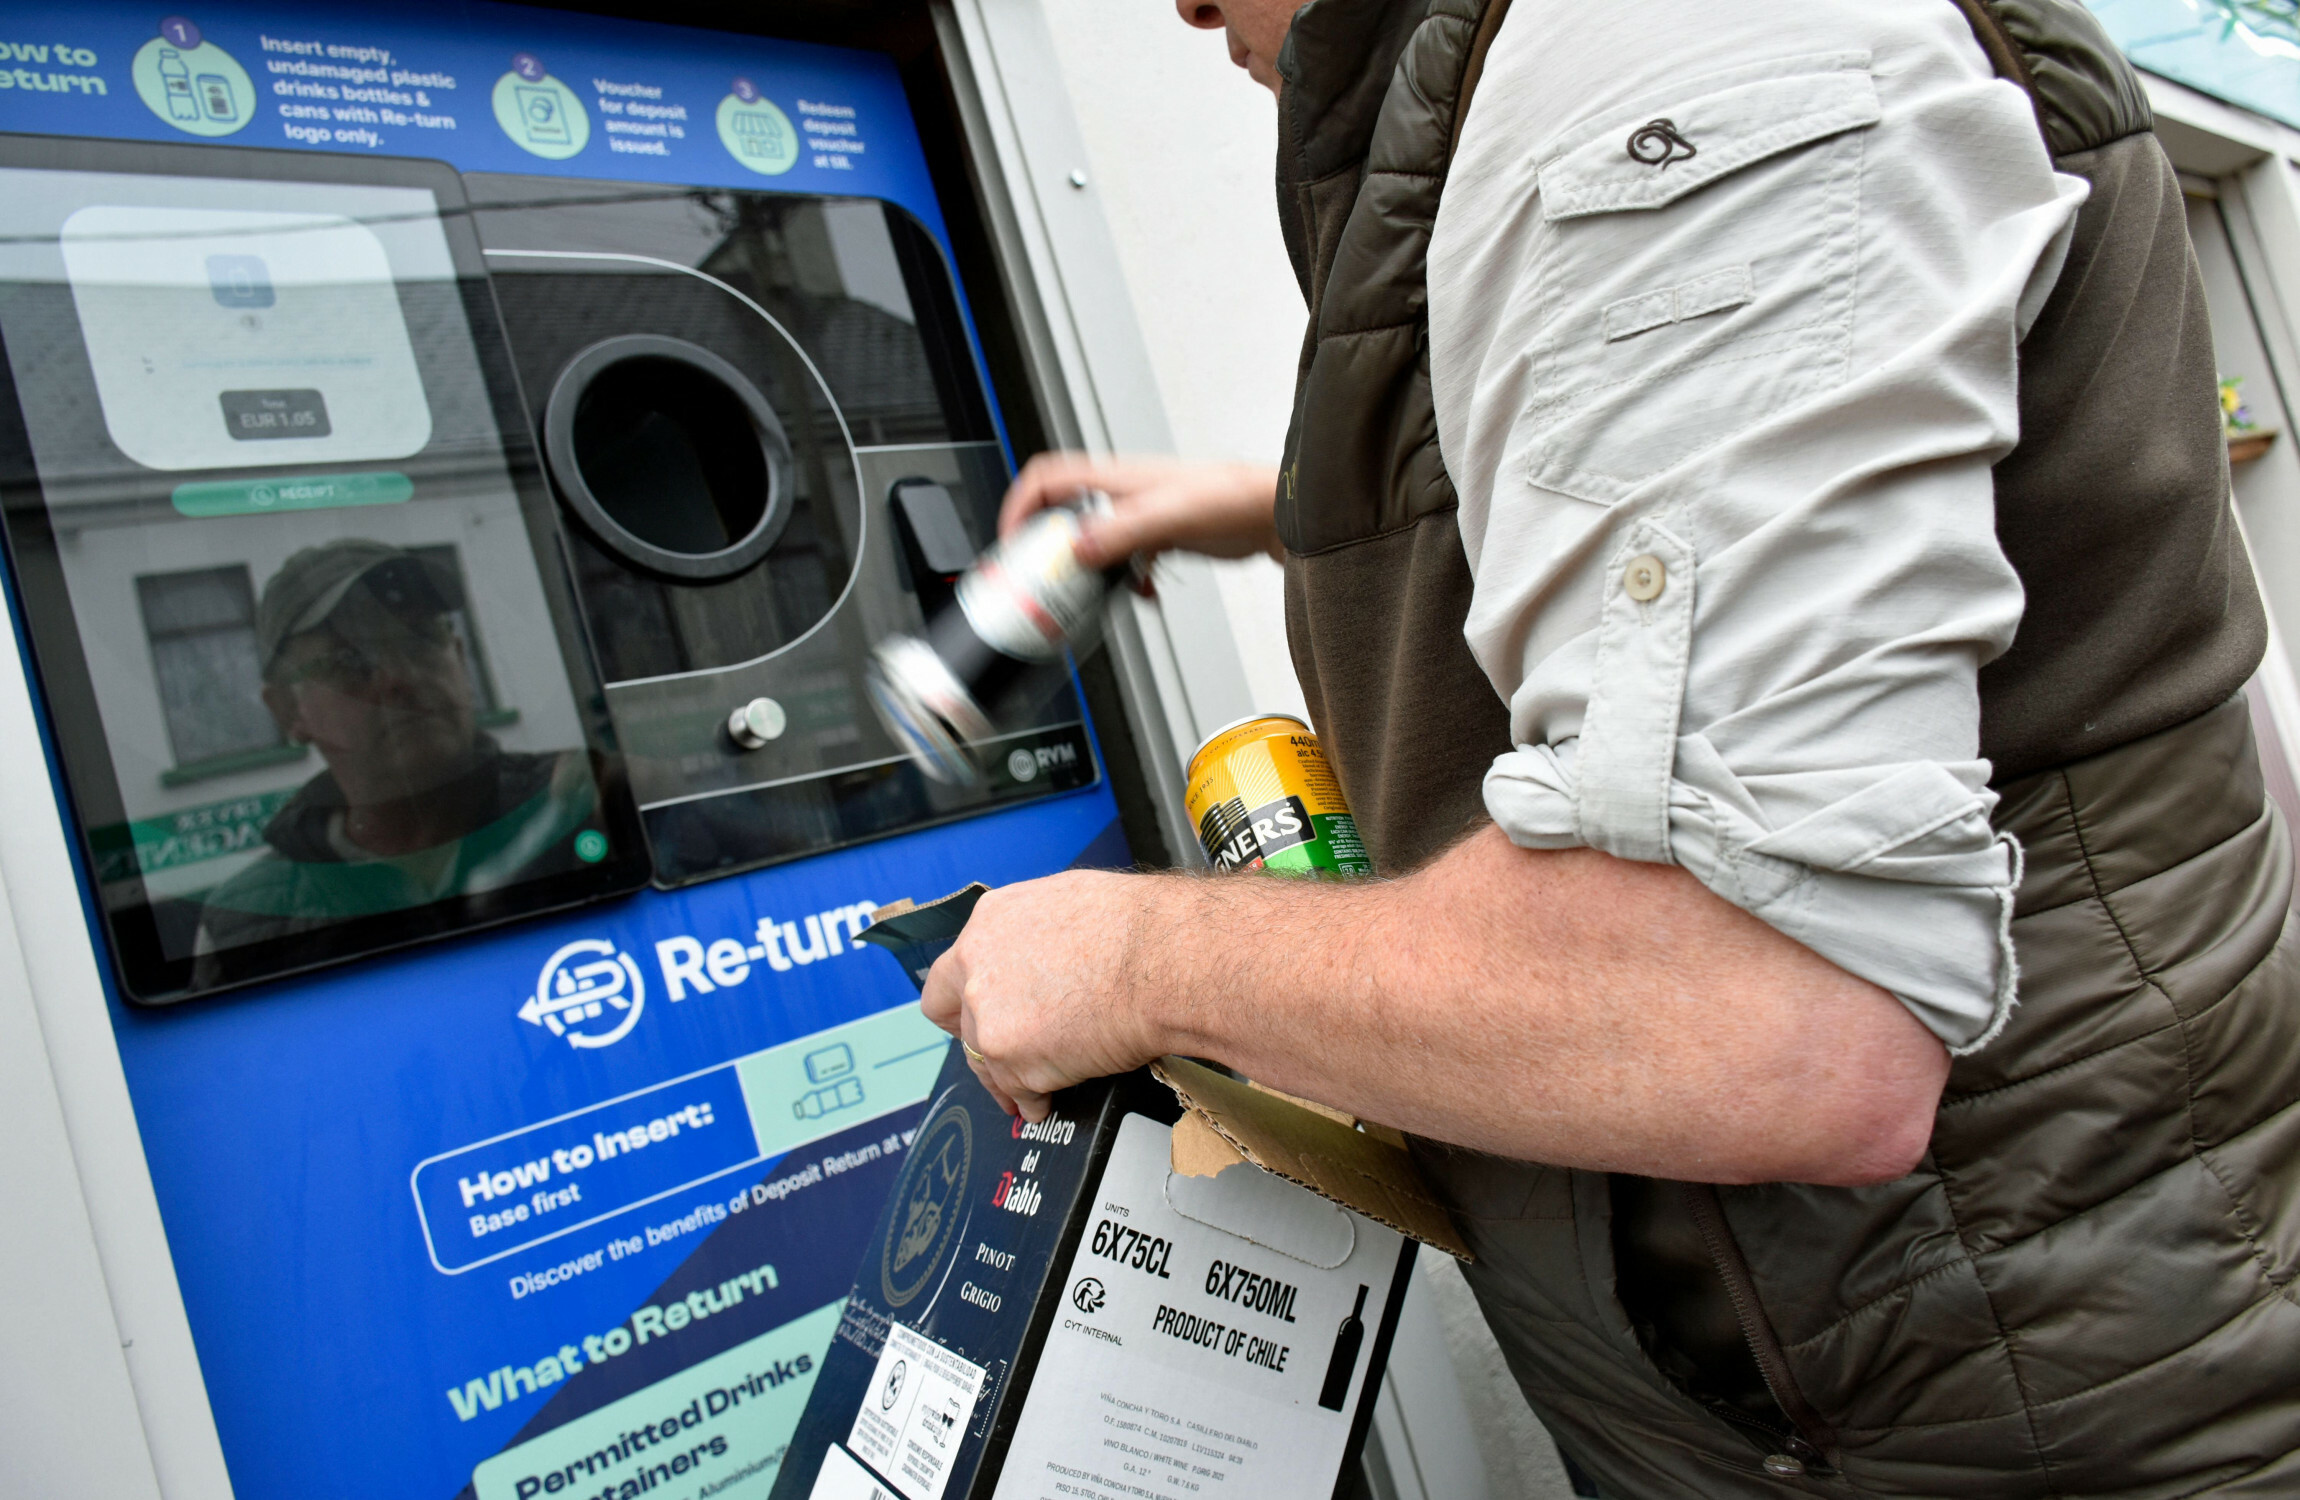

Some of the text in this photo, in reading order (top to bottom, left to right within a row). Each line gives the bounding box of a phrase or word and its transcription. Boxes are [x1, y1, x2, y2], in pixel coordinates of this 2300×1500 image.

[174, 24, 188, 41] 1
[0, 41, 98, 67] ow to
[260, 35, 397, 66] Insert empty,
[267, 59, 456, 91] undamaged plastic
[520, 57, 535, 76] 2
[0, 68, 108, 95] eturn
[273, 79, 431, 107] drinks bottles &
[593, 78, 662, 100] Voucher
[279, 103, 457, 130] cans with Re-turn
[599, 98, 688, 124] for deposit
[797, 99, 856, 119] Redeem
[284, 123, 385, 148] logo only.
[605, 117, 685, 139] amount is
[803, 117, 857, 138] deposit
[610, 136, 671, 156] issued.
[808, 136, 865, 155] voucher
[240, 411, 316, 428] EUR 1.05
[1290, 736, 1320, 748] 440m
[1311, 749, 1325, 759] 4.5
[654, 899, 879, 1003] Re-turn
[1011, 1111, 1076, 1146] Casillero
[458, 1101, 715, 1208] How to Insert:
[1020, 1149, 1041, 1174] del
[992, 1171, 1042, 1217] Diablo
[469, 1181, 582, 1238] Base first
[509, 1249, 605, 1300] Discover
[607, 1232, 643, 1262] the
[646, 1203, 728, 1246] benefits
[729, 1191, 750, 1215] of
[751, 1163, 823, 1206] Deposit
[822, 1140, 881, 1178] Return
[882, 1132, 902, 1155] at
[1104, 1202, 1130, 1218] UNITS
[975, 1242, 1016, 1272] PINOT
[1091, 1219, 1173, 1280] 6X75CL
[960, 1281, 1002, 1314] GRIGIO
[1205, 1260, 1299, 1324] 6X750ML
[447, 1341, 584, 1423] What
[582, 1325, 632, 1364] to
[630, 1263, 780, 1345] Return
[1064, 1319, 1123, 1347] CYT INTERNAL
[1153, 1304, 1290, 1374] PRODUCT OF CHILE
[1116, 1399, 1143, 1413] CONCHA
[514, 1353, 815, 1500] Permitted Drinks
[590, 1434, 728, 1500] tainers
[1046, 1461, 1081, 1479] PRODUCED
